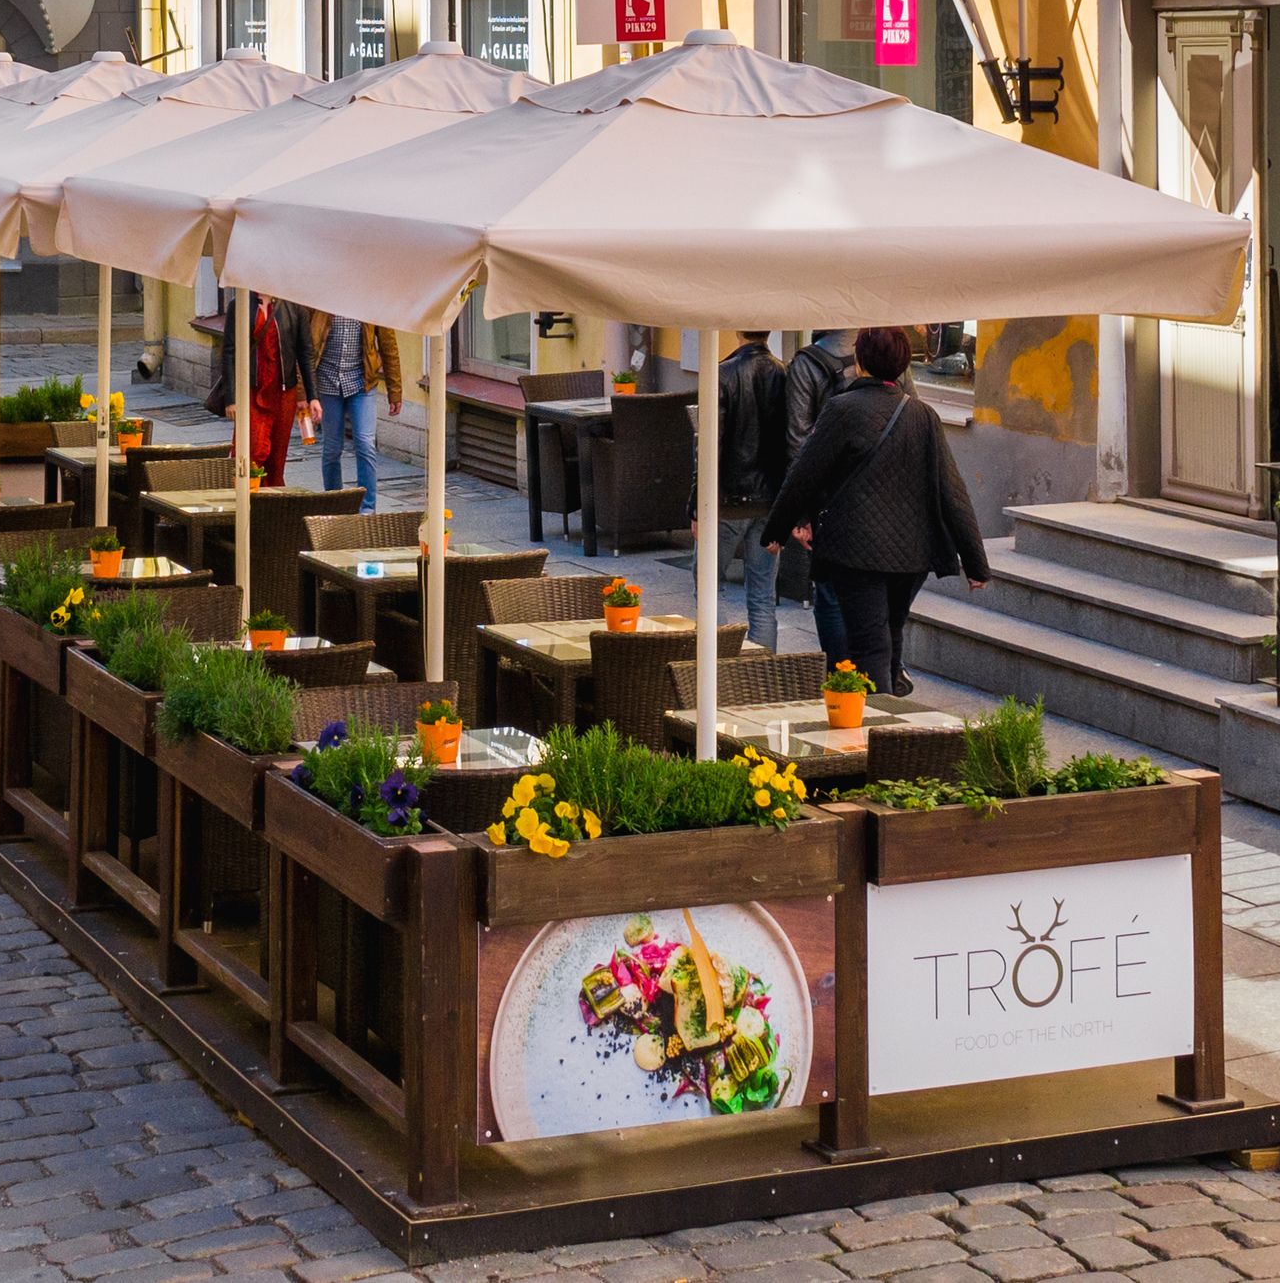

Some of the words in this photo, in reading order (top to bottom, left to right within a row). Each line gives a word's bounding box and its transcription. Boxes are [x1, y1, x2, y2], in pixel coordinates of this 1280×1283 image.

[625, 22, 657, 33] PIKK29
[882, 29, 910, 44] PIKK29
[913, 914, 1152, 1020] TROFÉ
[954, 1031, 1000, 1053] FOOD
[1002, 1028, 1023, 1048] OF
[1027, 1025, 1057, 1044] THE
[1060, 1019, 1114, 1040] NORTH
